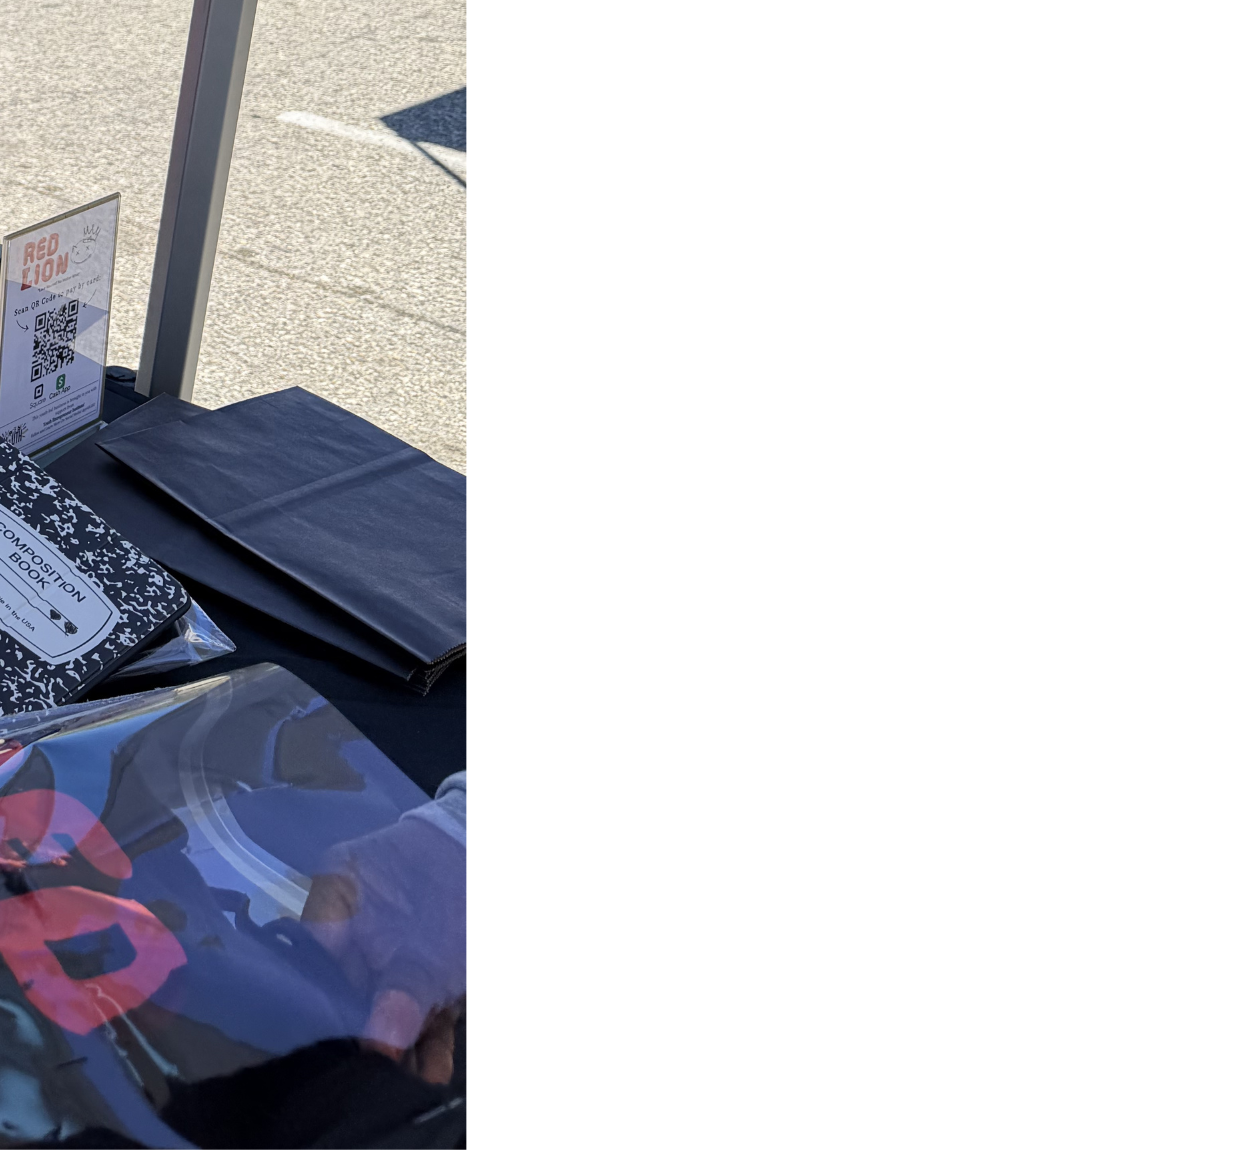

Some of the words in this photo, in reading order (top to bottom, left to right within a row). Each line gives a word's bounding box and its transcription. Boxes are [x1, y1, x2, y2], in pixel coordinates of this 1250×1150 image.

[23, 233, 59, 266] RED
[20, 252, 69, 291] LION
[13, 306, 29, 317] Scan
[41, 293, 56, 305] Code
[65, 284, 77, 297] pay
[77, 281, 85, 291] by
[48, 390, 61, 400] Cash
[61, 385, 71, 394] App
[8, 551, 51, 590] BOOK
[5, 604, 12, 613] in
[11, 609, 21, 621] the
[21, 617, 36, 633] USA
